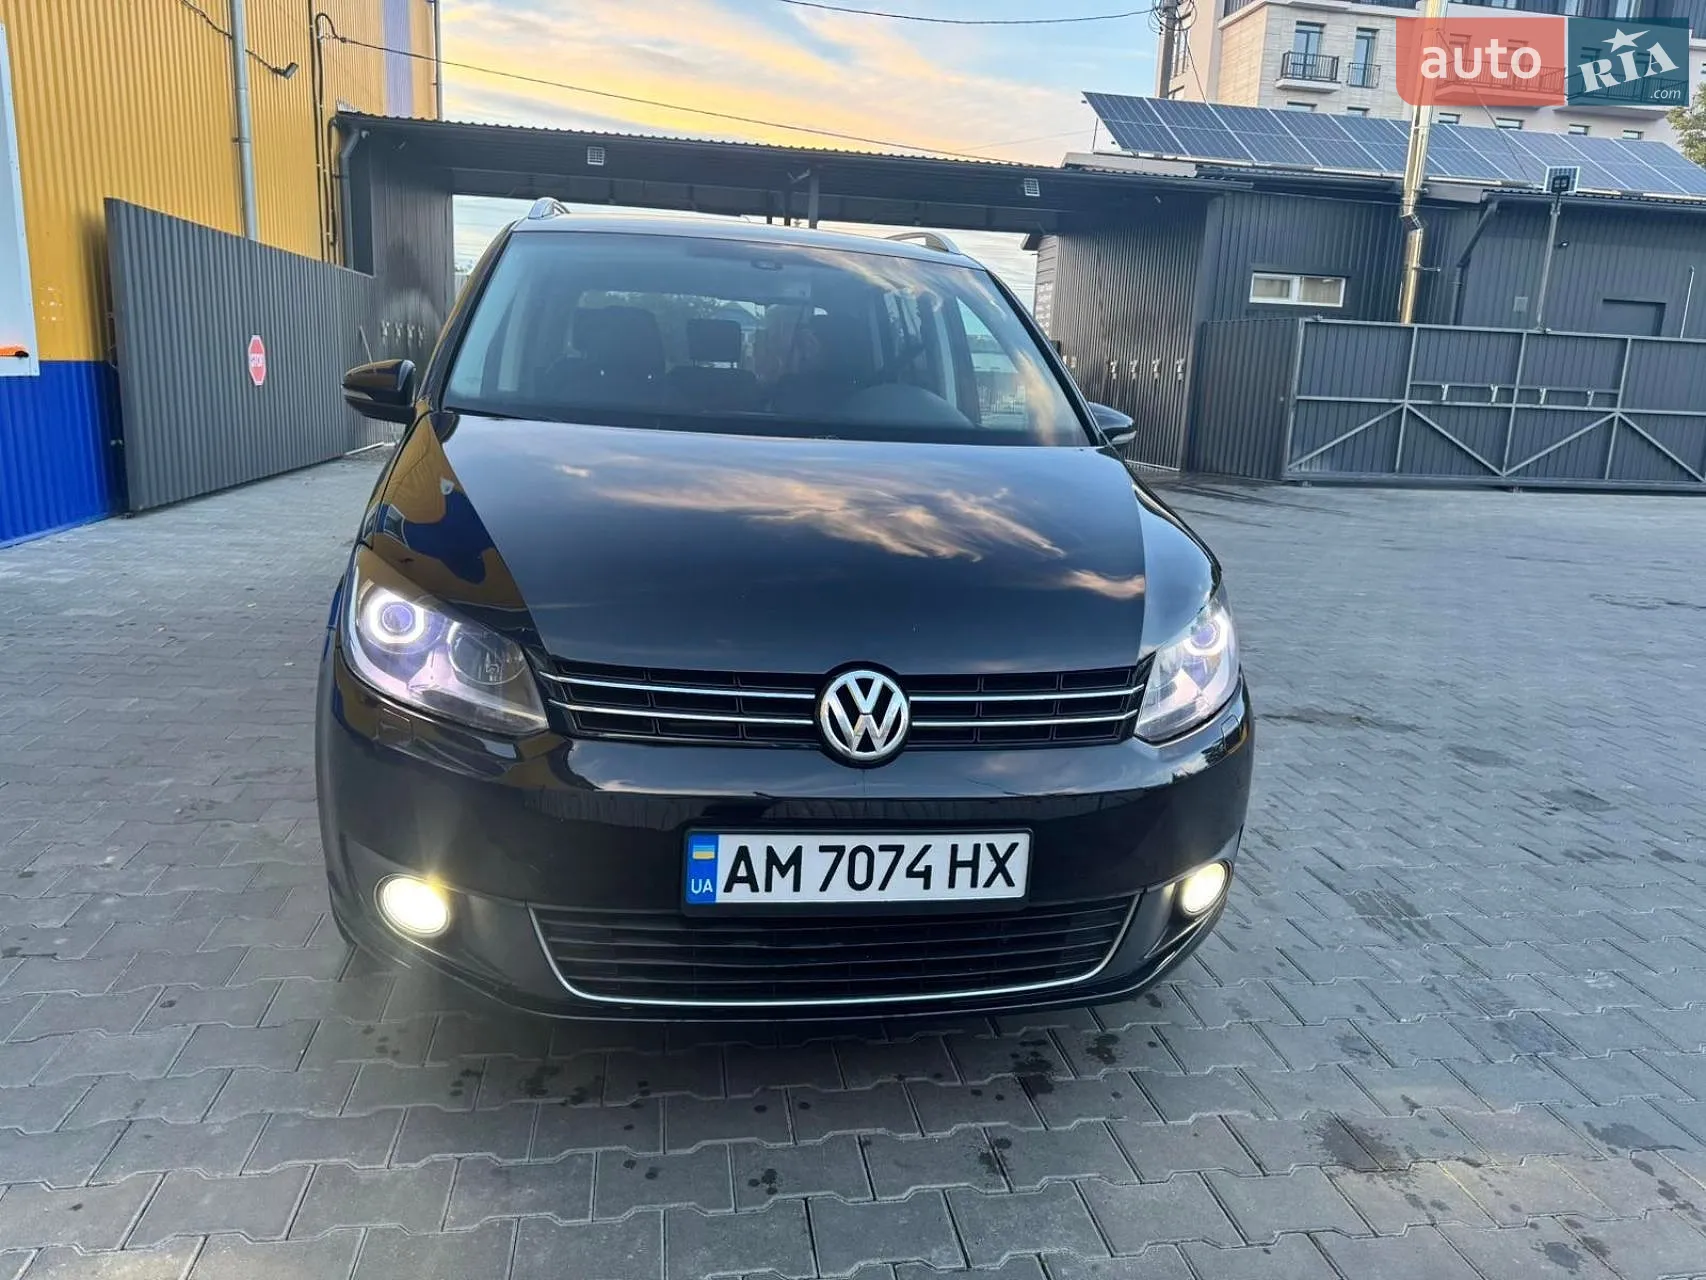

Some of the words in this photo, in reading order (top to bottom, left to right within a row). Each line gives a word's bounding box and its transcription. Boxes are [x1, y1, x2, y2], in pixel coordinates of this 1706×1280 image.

[723, 845, 803, 893] AM
[818, 844, 933, 892] 7074
[948, 842, 1019, 889] HX
[691, 878, 713, 893] UA
